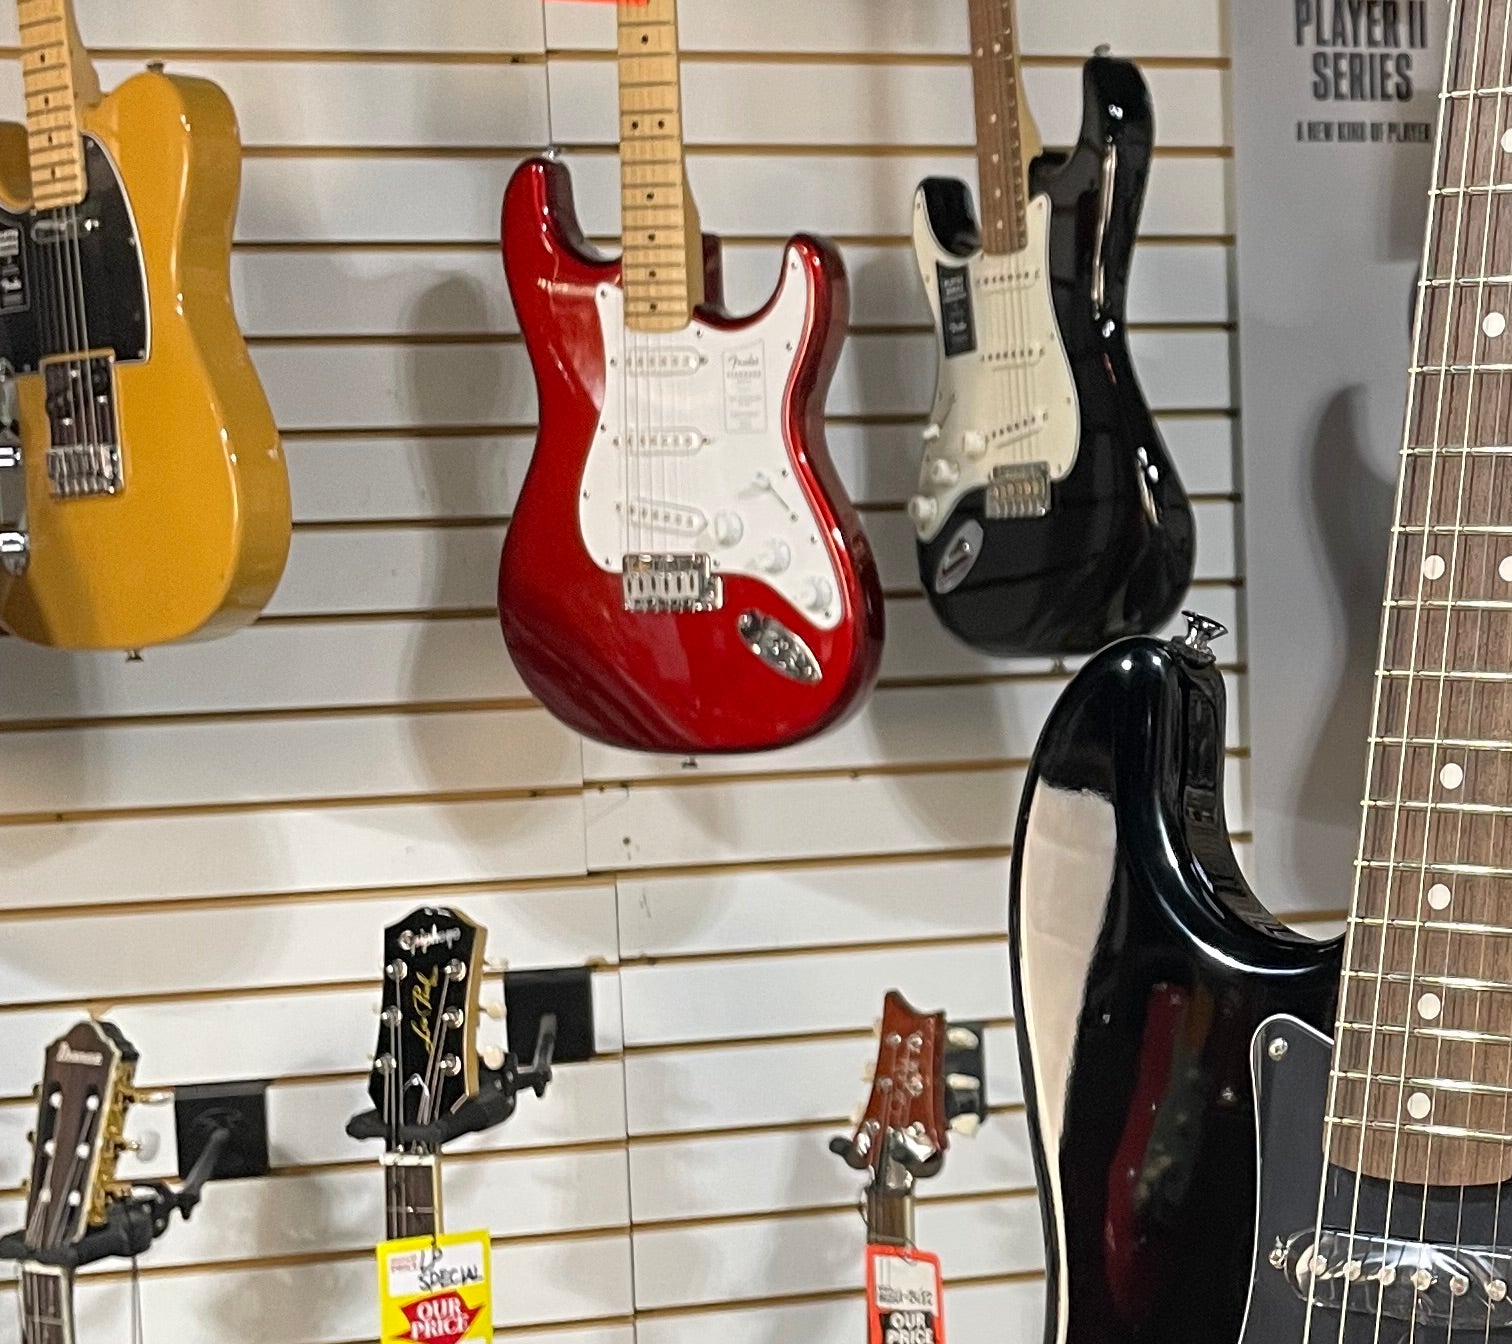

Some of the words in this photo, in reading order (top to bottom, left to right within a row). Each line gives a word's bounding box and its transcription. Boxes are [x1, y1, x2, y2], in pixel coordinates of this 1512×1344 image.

[1409, 0, 1428, 49] II
[1312, 52, 1413, 101] SERIES
[416, 1297, 462, 1320] OUR
[890, 1311, 926, 1330] OUR
[411, 1313, 470, 1340] PRICE
